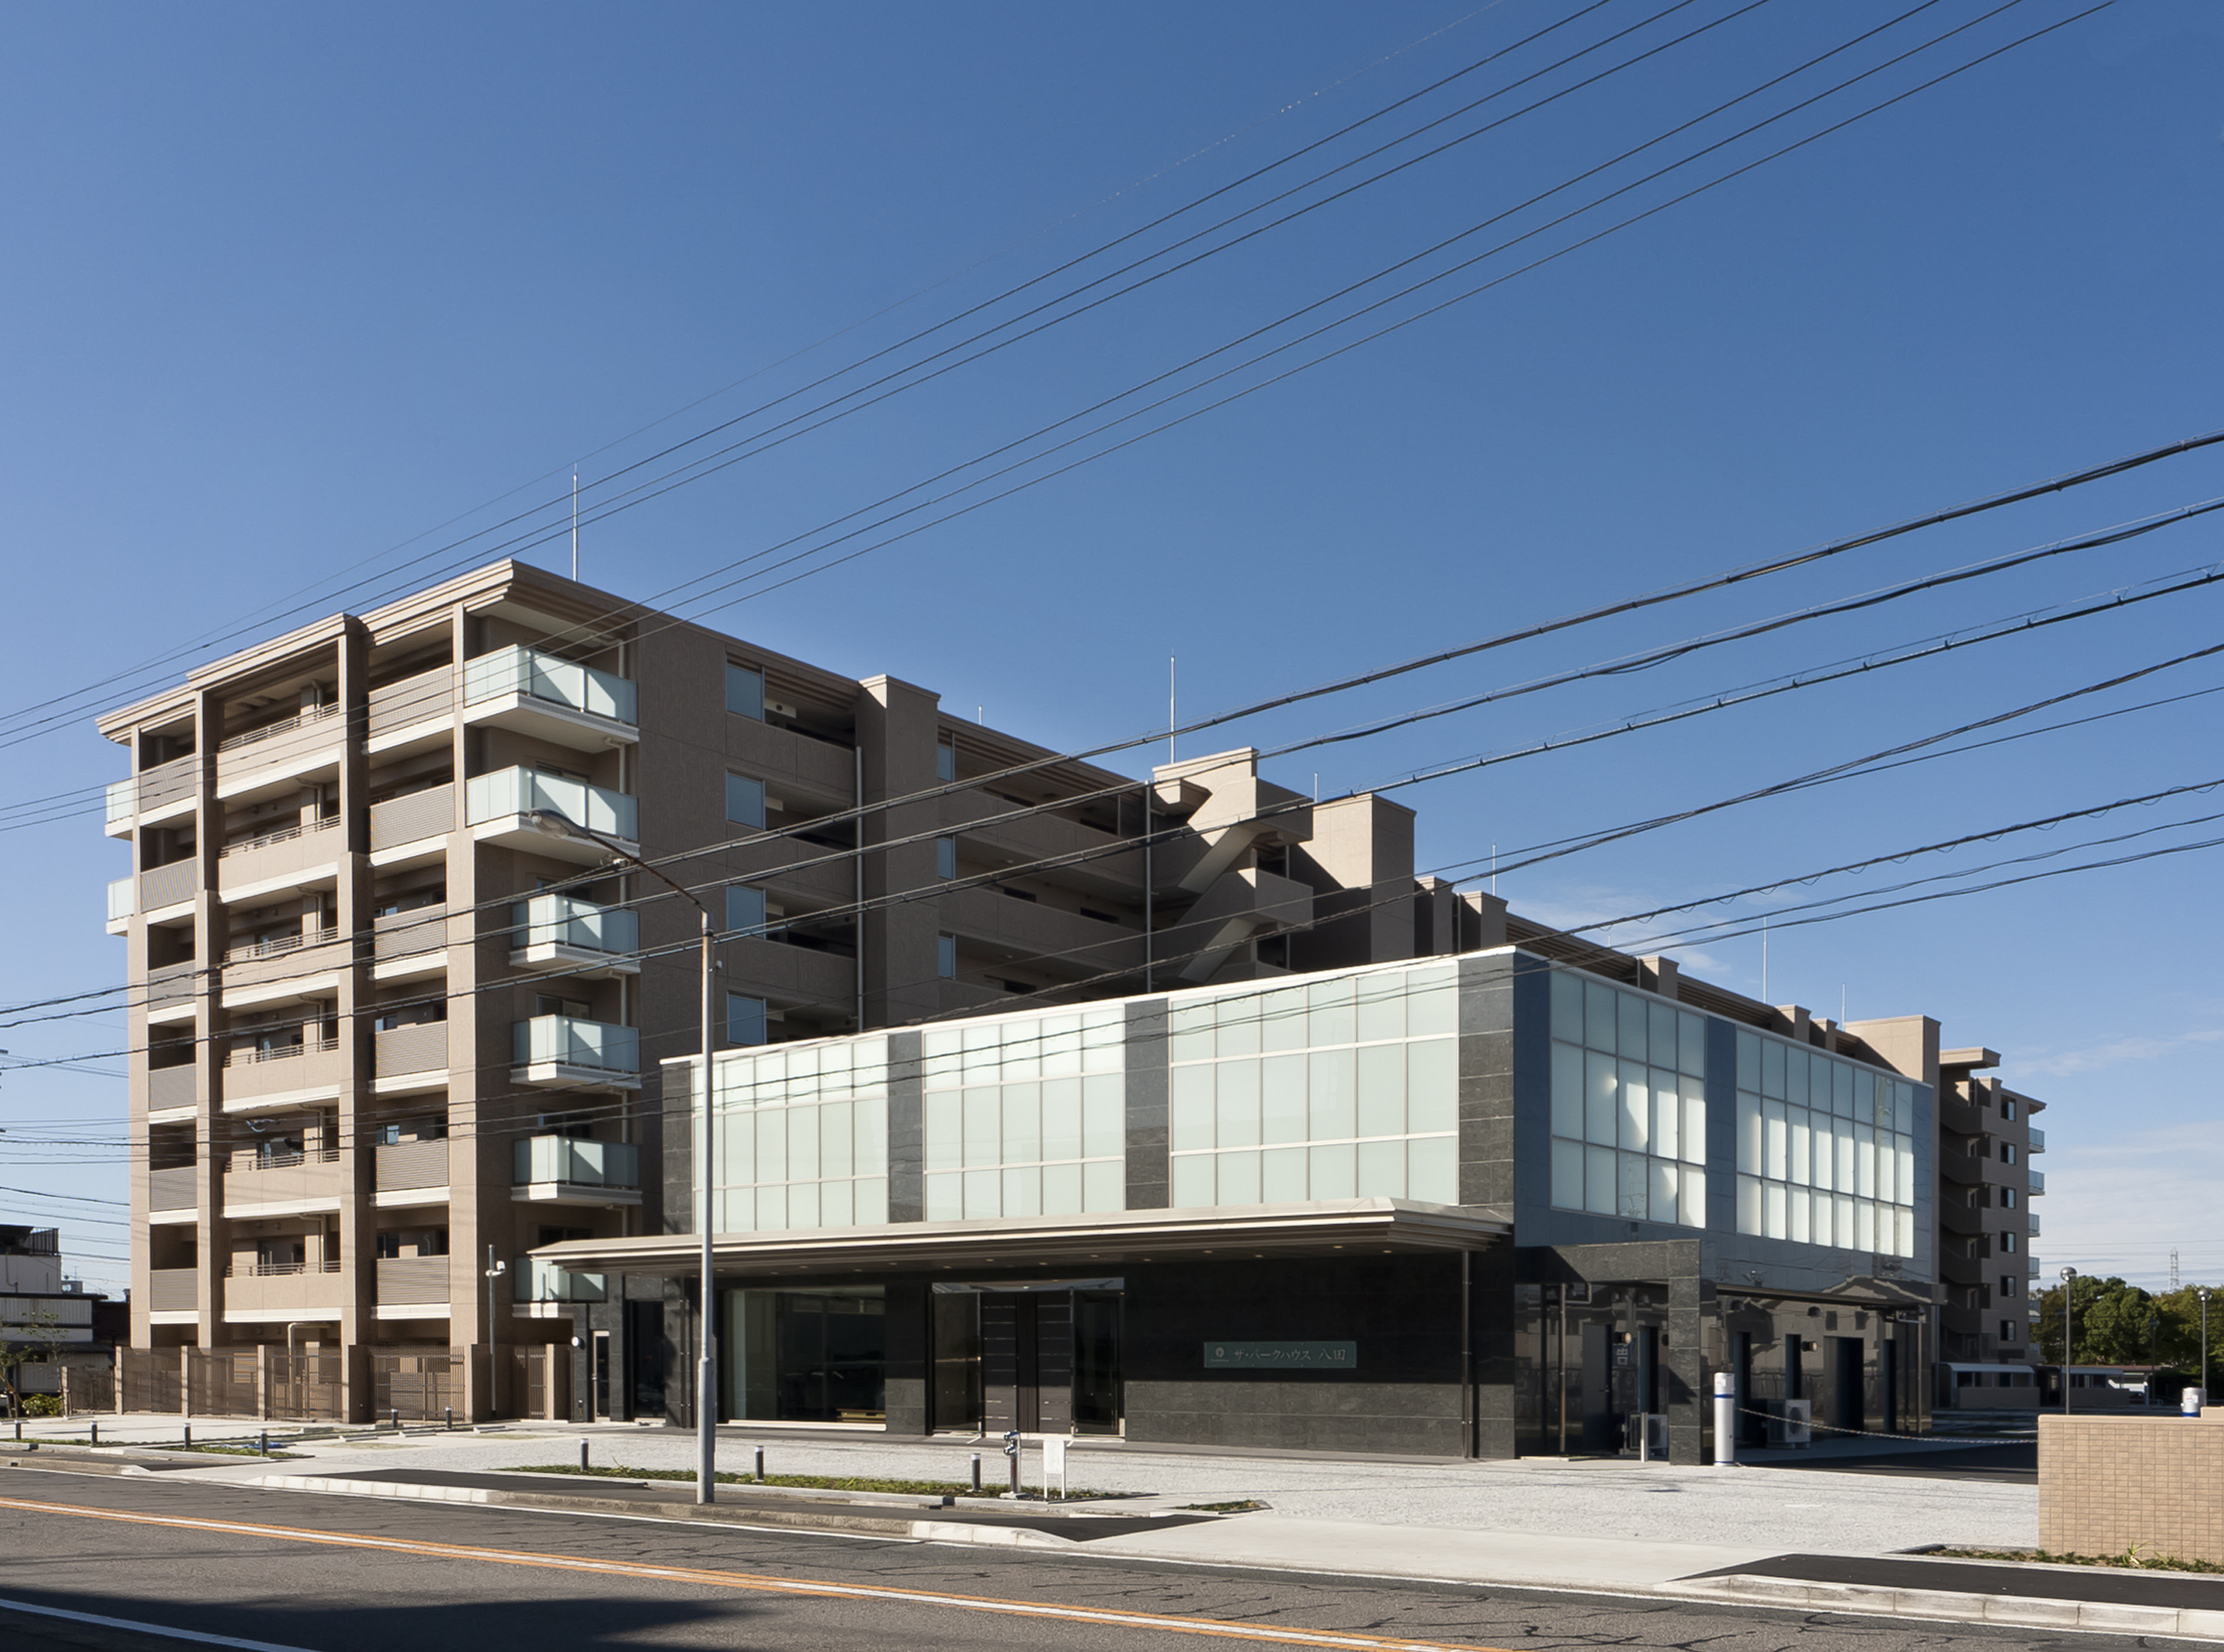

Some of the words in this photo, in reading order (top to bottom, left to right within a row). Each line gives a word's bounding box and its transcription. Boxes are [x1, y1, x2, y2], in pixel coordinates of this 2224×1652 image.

[1233, 1347, 1311, 1361] ザ・パークハウス
[1318, 1347, 1346, 1361] 八田
